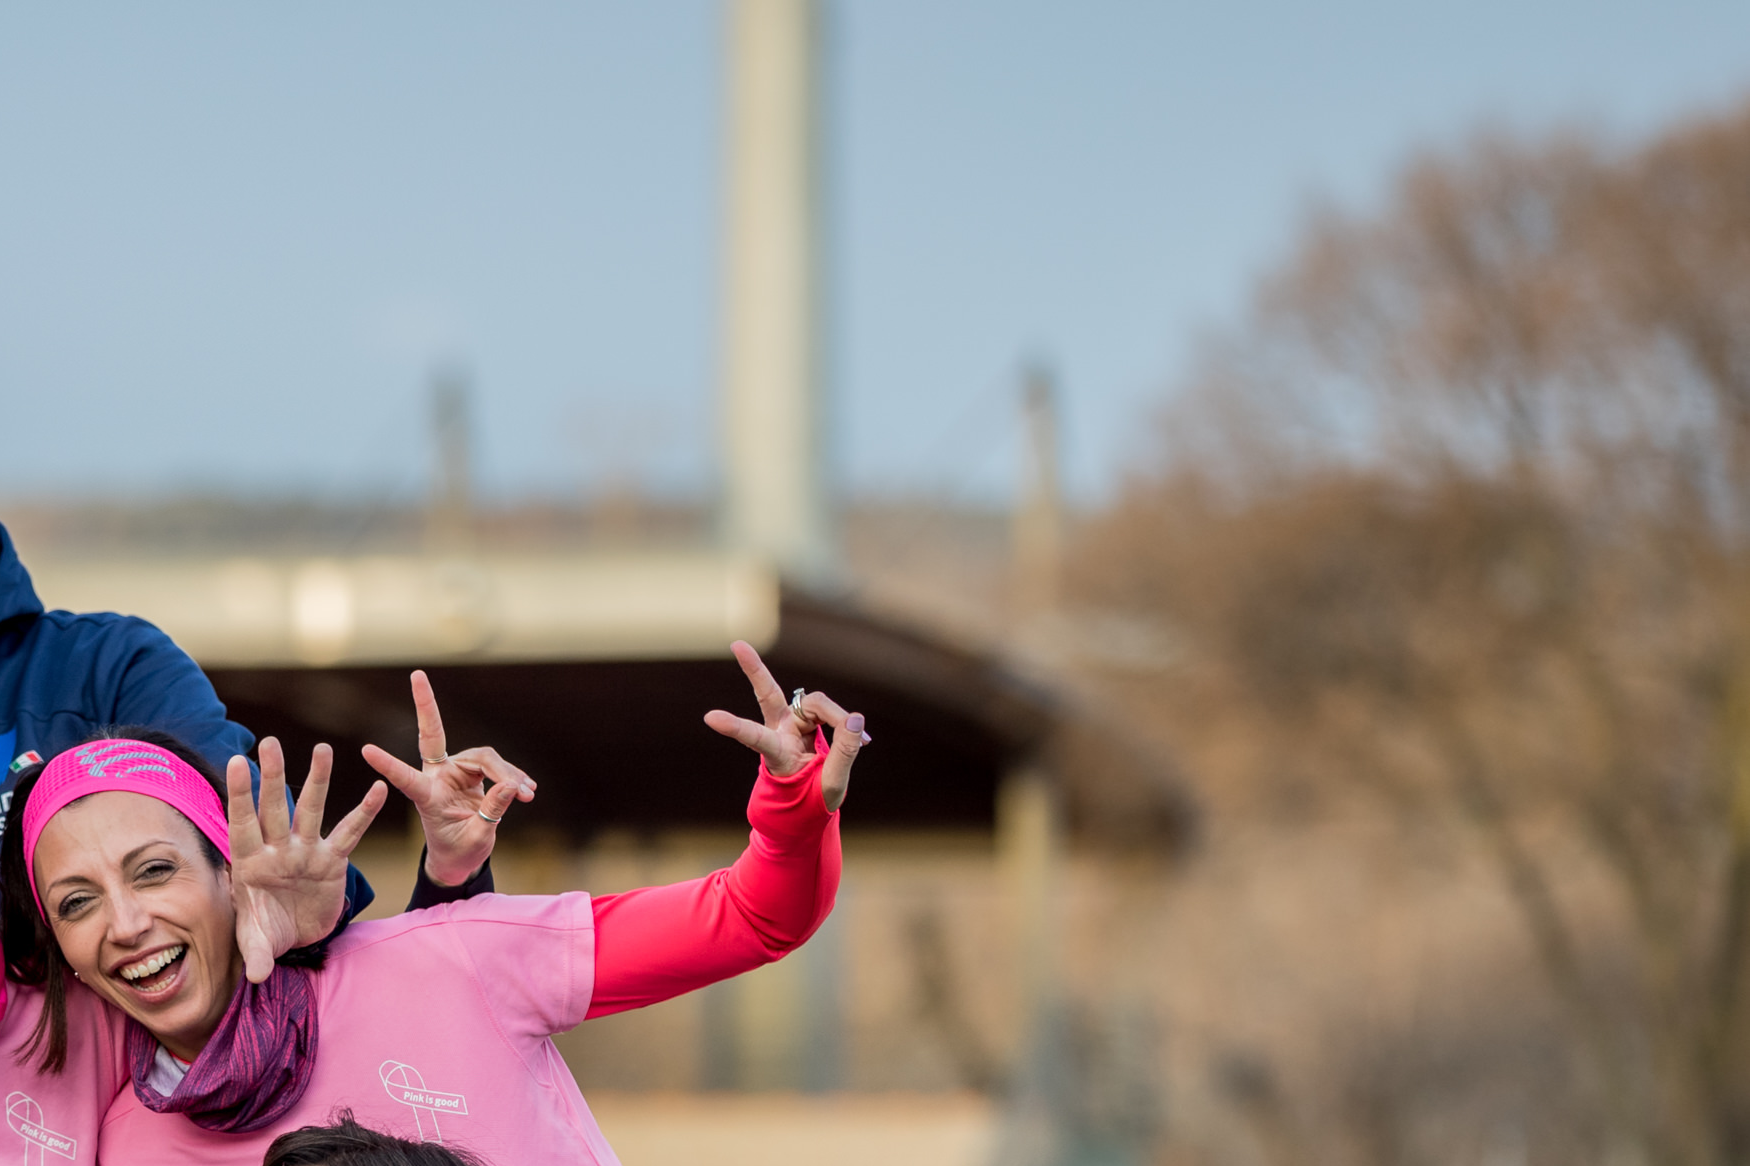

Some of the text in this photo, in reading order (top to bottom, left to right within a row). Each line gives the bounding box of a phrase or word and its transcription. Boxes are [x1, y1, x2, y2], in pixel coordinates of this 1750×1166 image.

[403, 1091, 459, 1108] Pink is good
[20, 1123, 71, 1151] Pink is good
